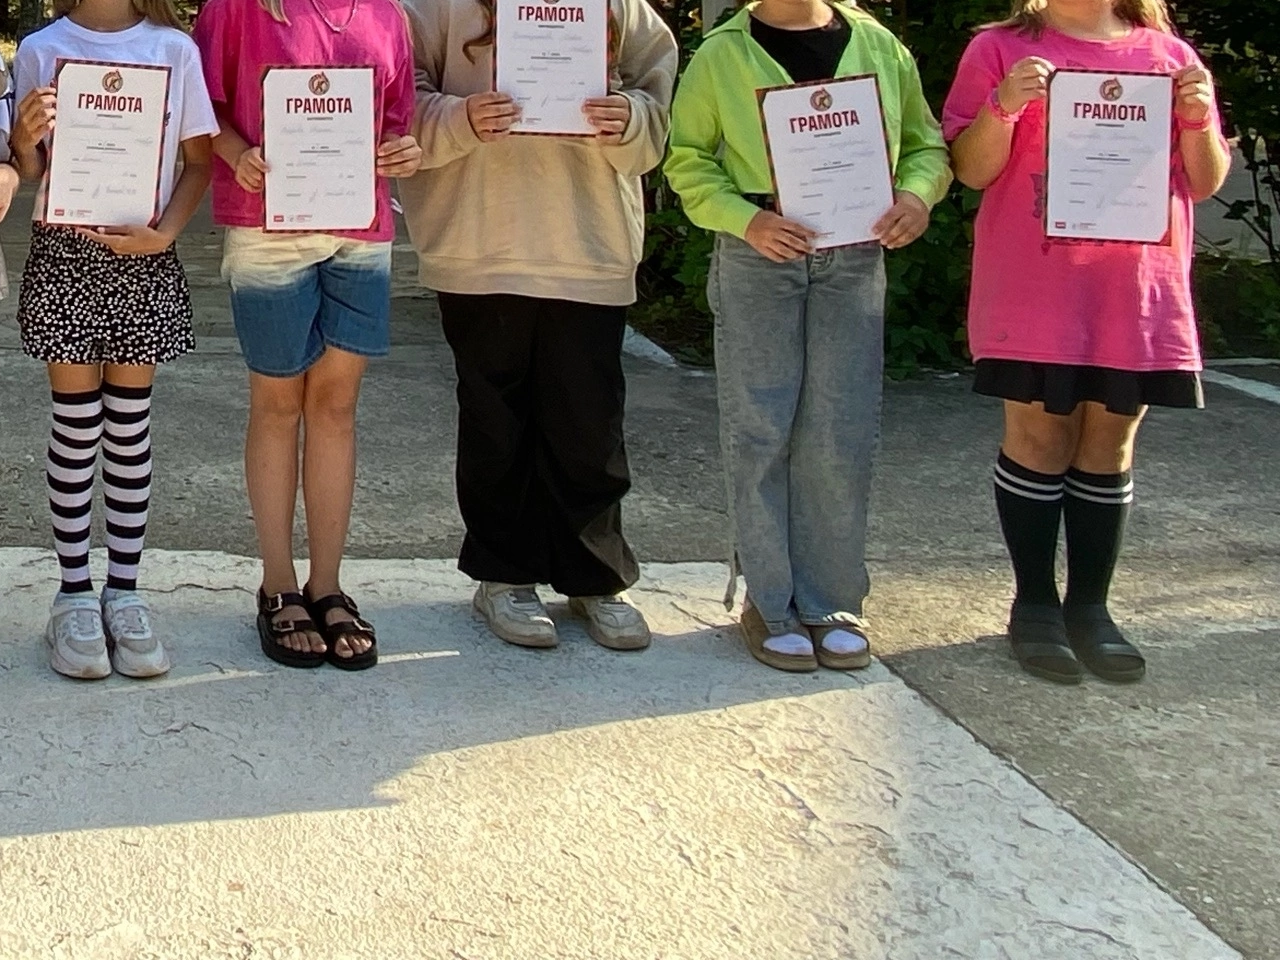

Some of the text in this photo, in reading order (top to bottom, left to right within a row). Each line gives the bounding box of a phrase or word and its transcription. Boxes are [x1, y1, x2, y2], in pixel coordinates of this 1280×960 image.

[518, 5, 585, 23] ГРАМОТА
[77, 91, 143, 114] ГРАМОТА
[286, 97, 353, 114] ГРАМОТА
[1073, 102, 1147, 122] ГРАМОТА
[789, 108, 860, 136] ГРАМОТА
